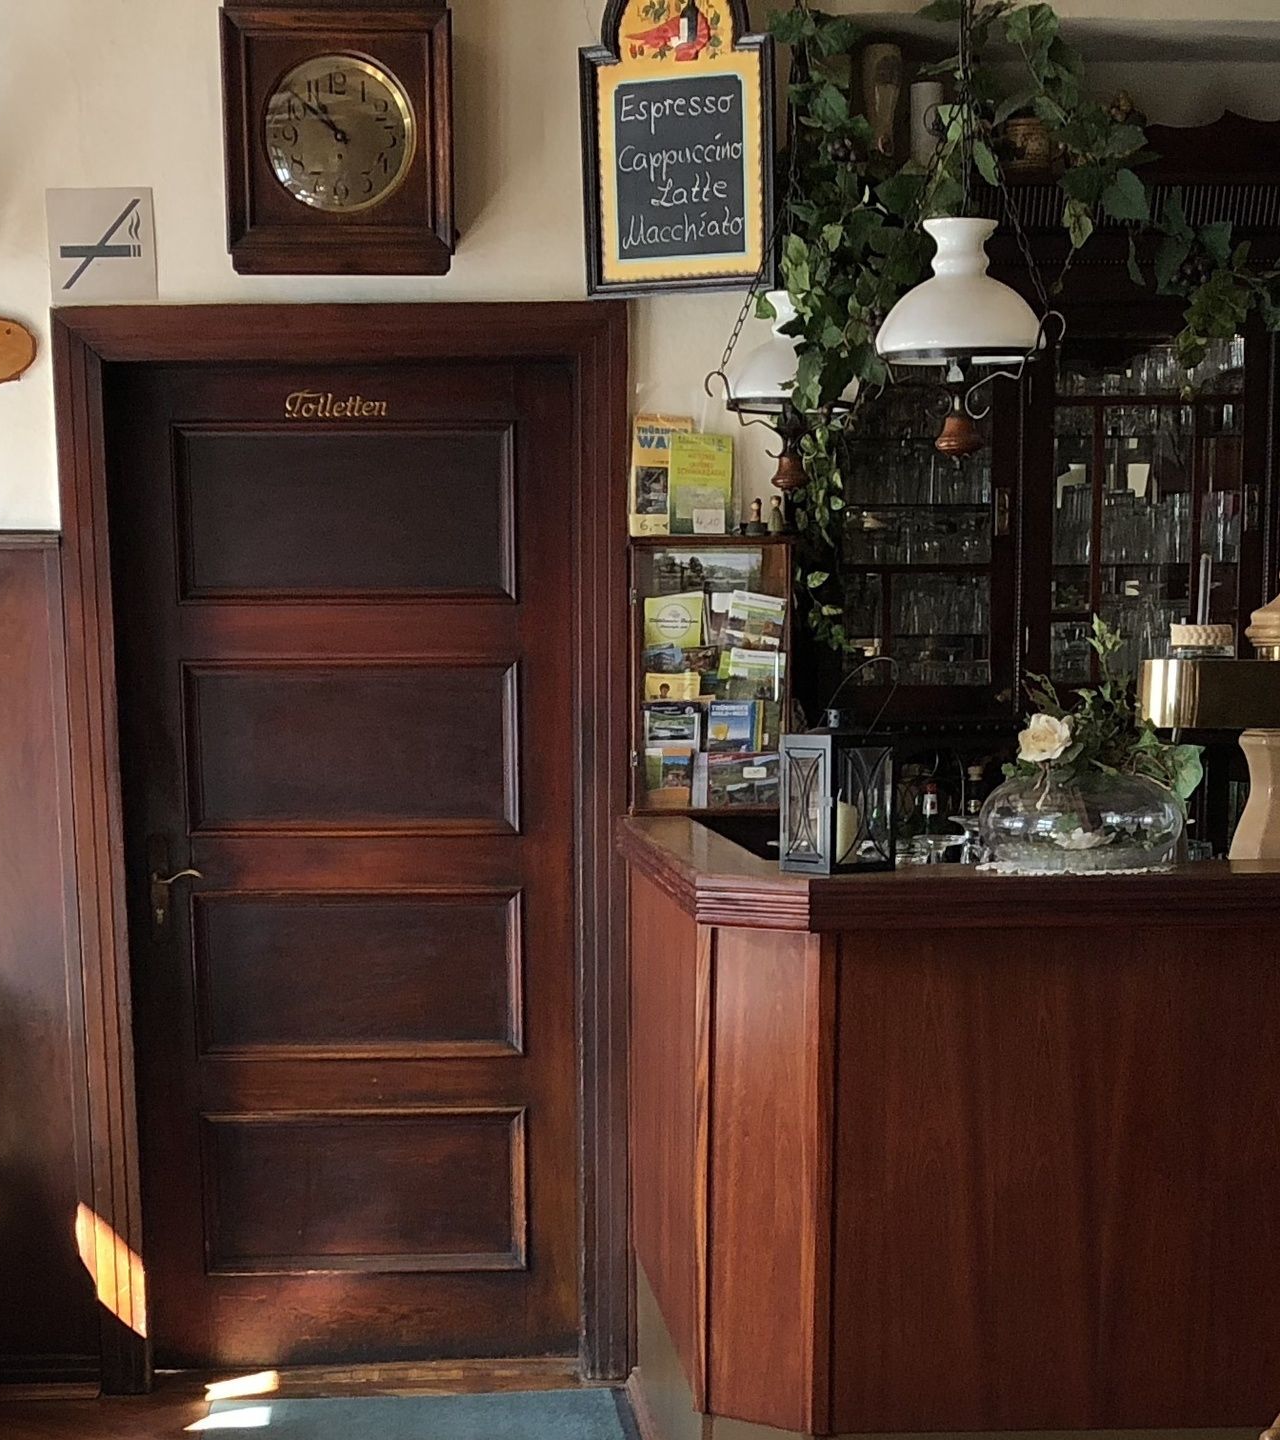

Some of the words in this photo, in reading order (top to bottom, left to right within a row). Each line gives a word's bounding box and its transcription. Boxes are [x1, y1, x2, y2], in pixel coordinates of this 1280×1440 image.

[620, 94, 734, 135] Espresso
[619, 133, 743, 182] Cappuccino
[651, 171, 727, 207] Latte
[622, 206, 744, 250] Macchiato
[285, 389, 387, 418] Toiletten
[637, 435, 670, 448] WA
